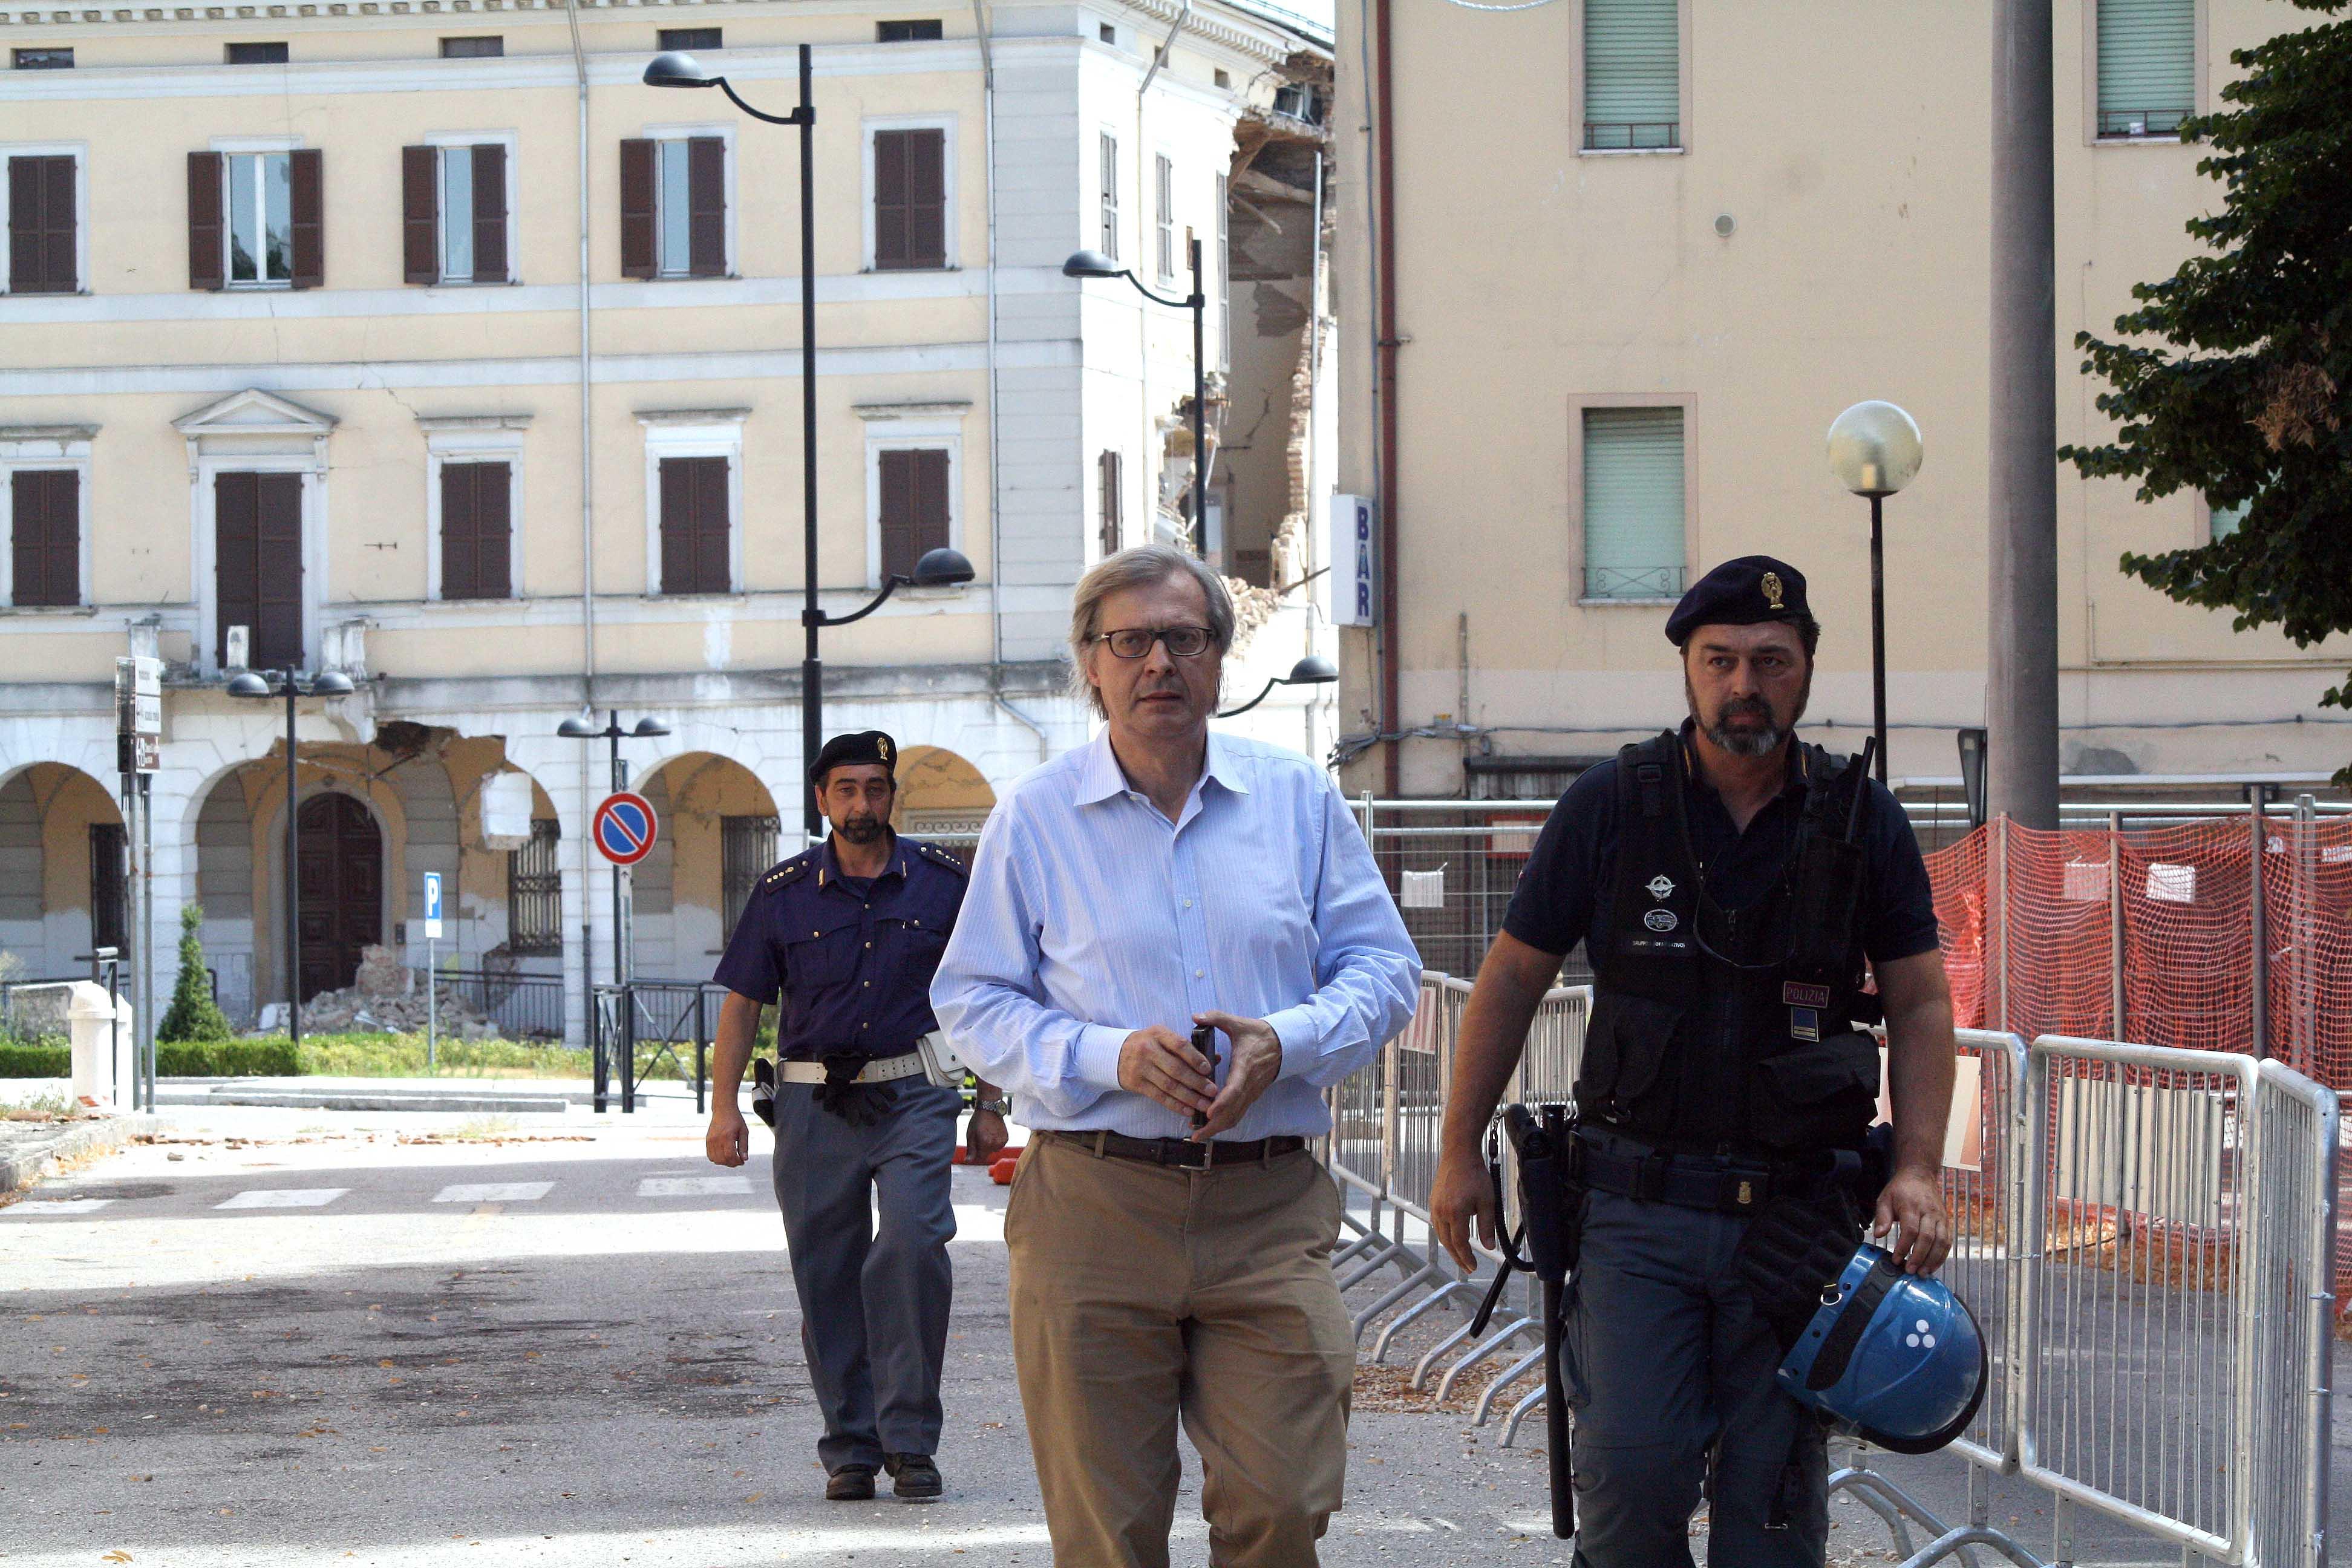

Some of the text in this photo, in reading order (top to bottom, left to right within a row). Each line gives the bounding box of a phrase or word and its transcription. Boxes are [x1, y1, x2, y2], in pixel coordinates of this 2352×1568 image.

[1357, 506, 1370, 617] BAR
[427, 878, 439, 916] P
[1786, 987, 1825, 1002] POLIZIA
